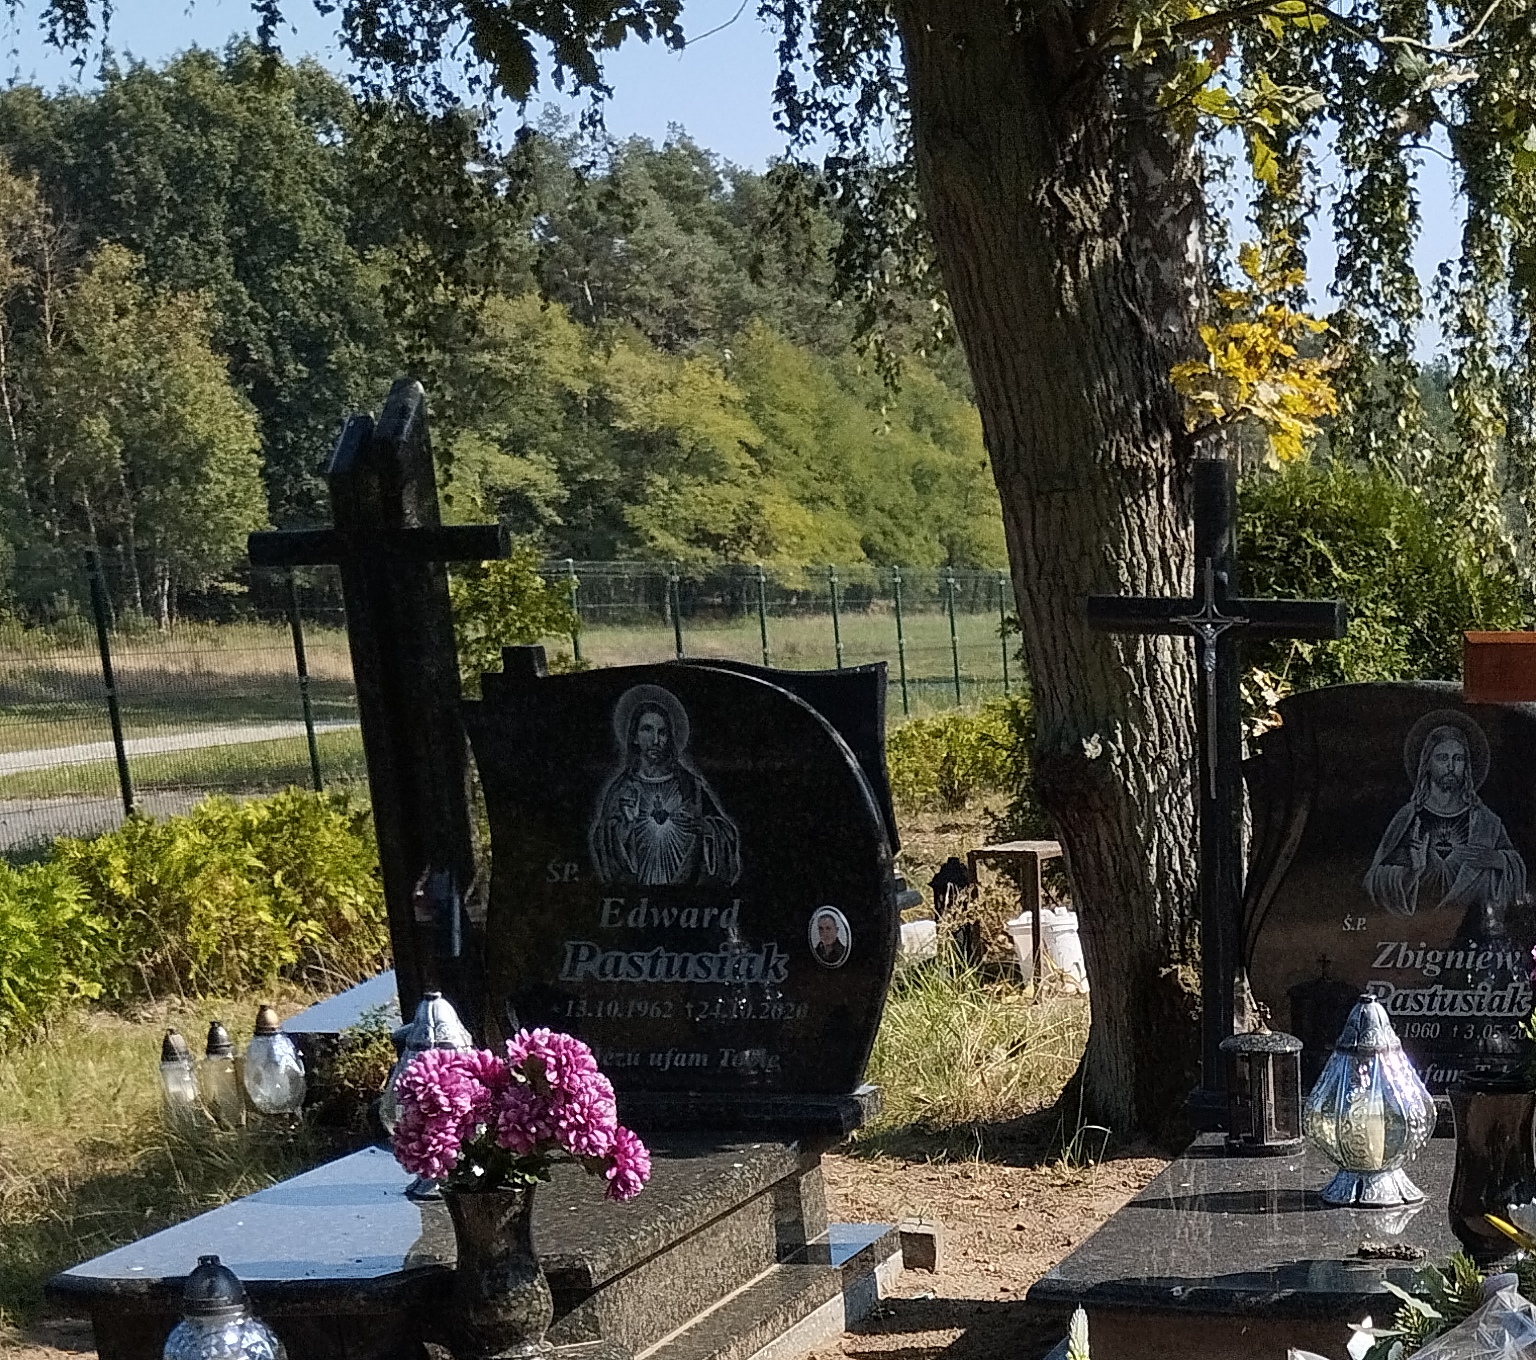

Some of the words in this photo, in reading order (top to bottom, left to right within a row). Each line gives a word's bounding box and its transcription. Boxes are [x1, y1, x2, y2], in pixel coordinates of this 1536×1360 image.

[600, 897, 741, 929] Edward
[559, 940, 790, 983] Pastusiak
[1371, 941, 1521, 977] Zbigniew
[1366, 980, 1534, 1017] Pastusiak
[648, 1048, 709, 1071] ufam
